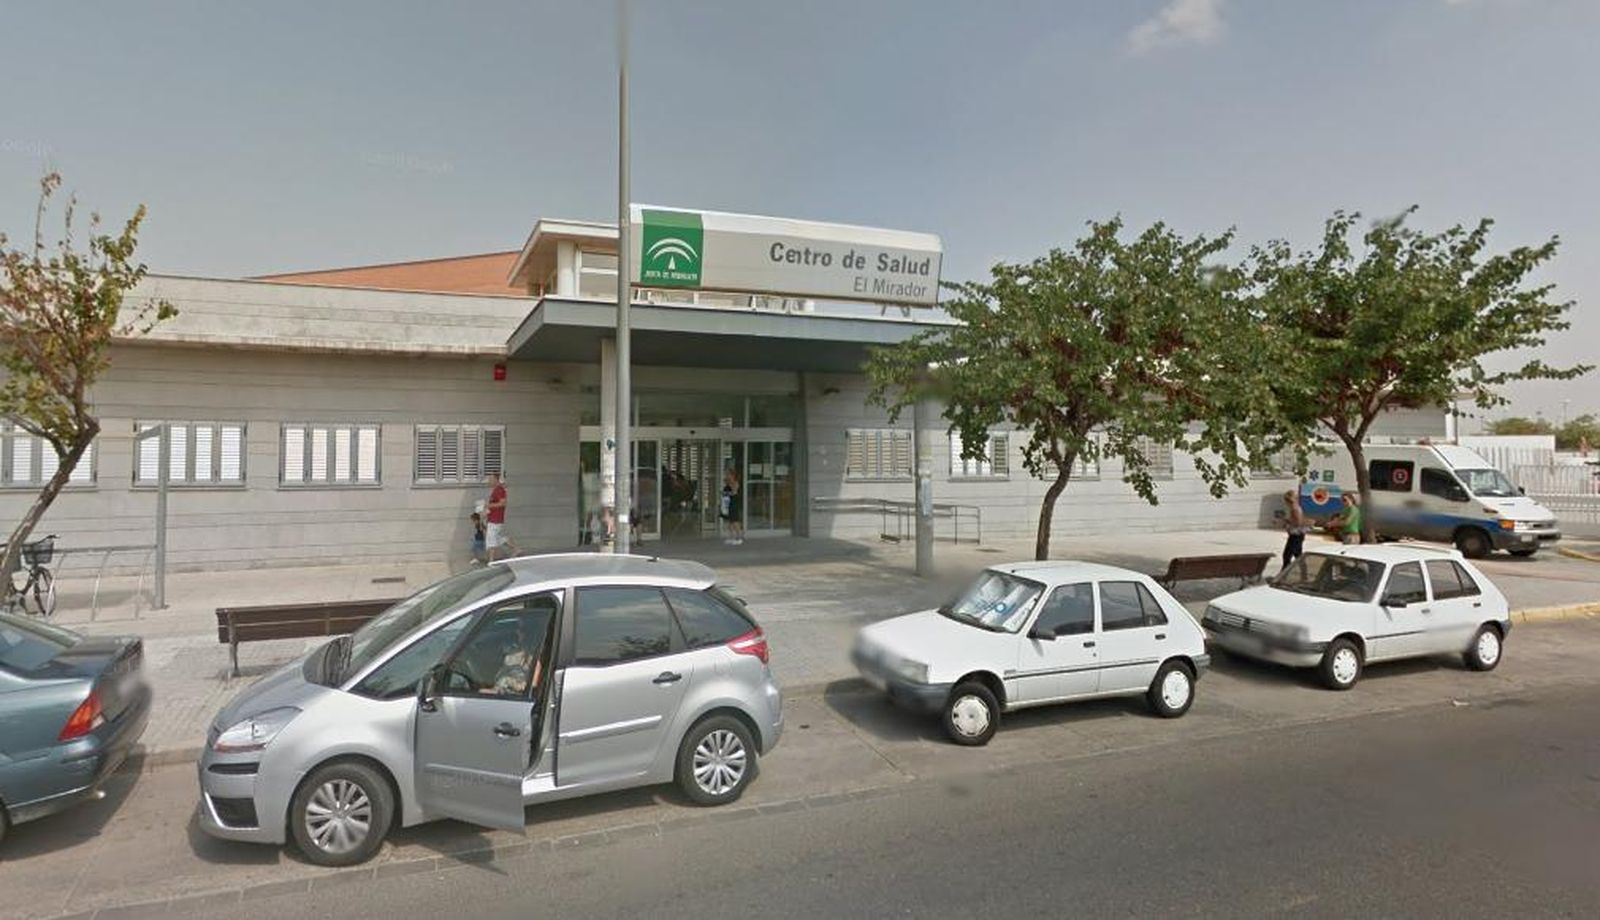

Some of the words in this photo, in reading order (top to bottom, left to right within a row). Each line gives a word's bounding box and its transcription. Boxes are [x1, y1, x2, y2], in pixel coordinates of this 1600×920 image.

[842, 248, 866, 270] de
[877, 253, 931, 276] Salud
[854, 276, 868, 293] El
[873, 278, 928, 297] Mirador
